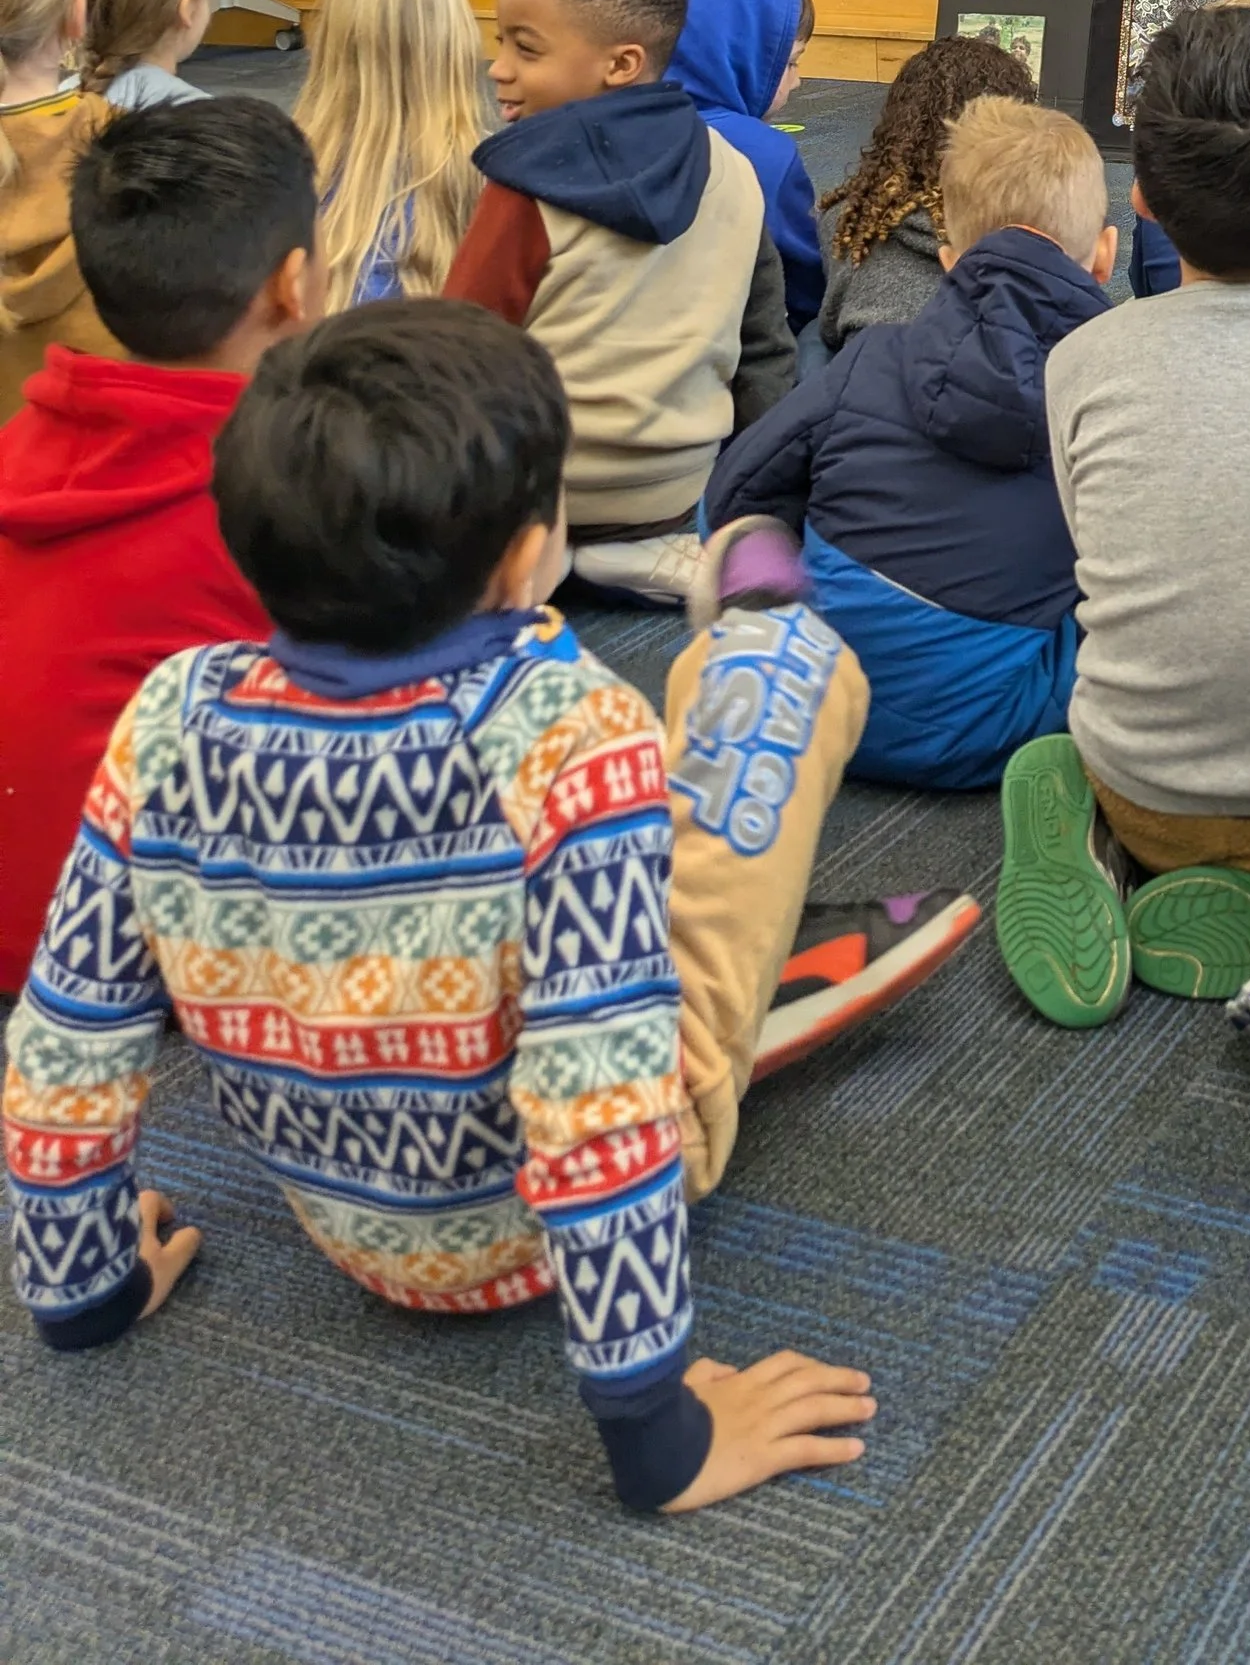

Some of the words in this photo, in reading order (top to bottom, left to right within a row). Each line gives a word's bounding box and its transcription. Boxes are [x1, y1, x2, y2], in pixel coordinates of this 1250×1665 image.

[668, 606, 792, 836] AST
[758, 603, 842, 754] OTTA
[728, 748, 798, 856] GO
